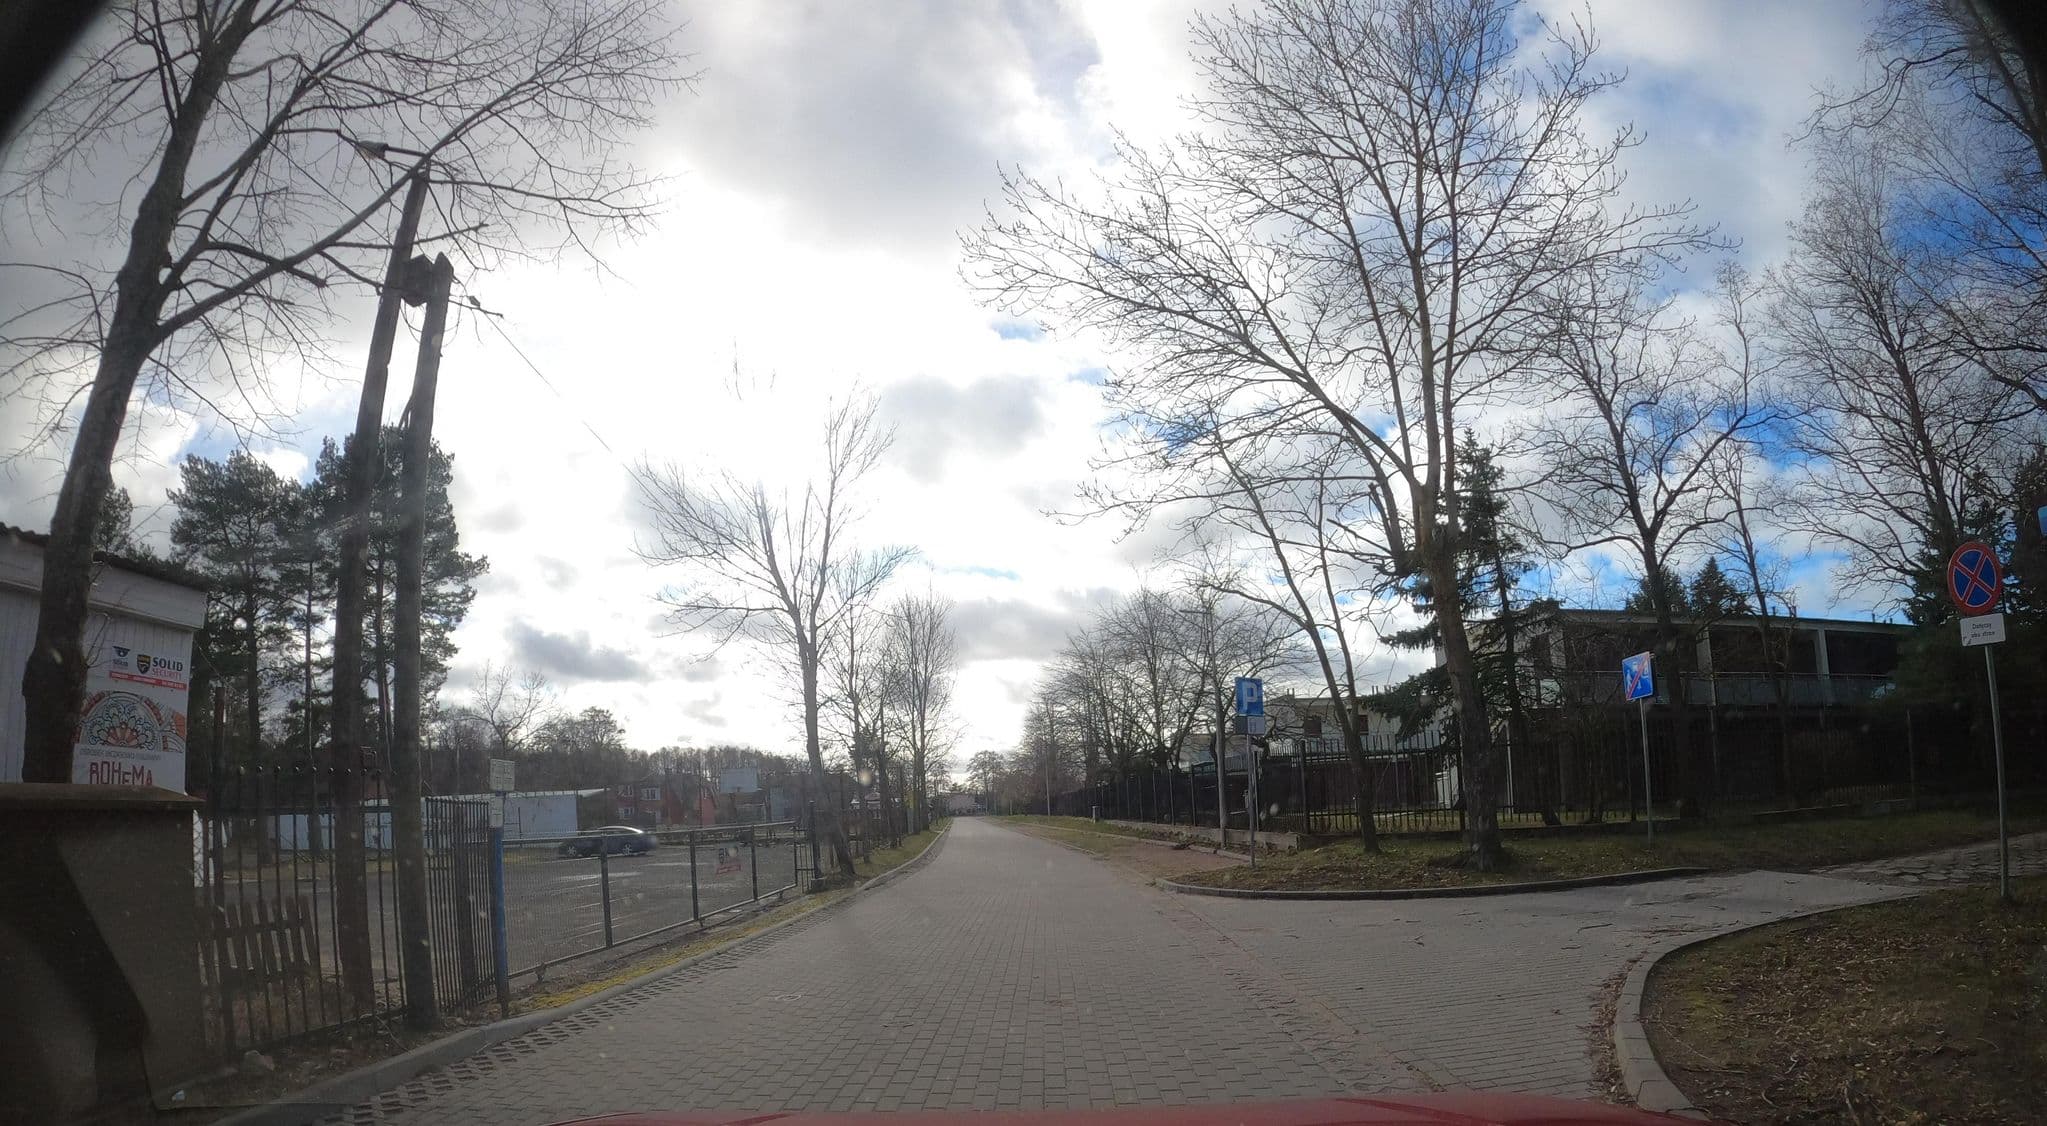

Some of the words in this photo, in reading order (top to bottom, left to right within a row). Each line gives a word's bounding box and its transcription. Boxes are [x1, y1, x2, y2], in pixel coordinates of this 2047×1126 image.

[152, 656, 183, 671] SOLID
[152, 668, 182, 680] SECURITY
[1242, 682, 1258, 713] P
